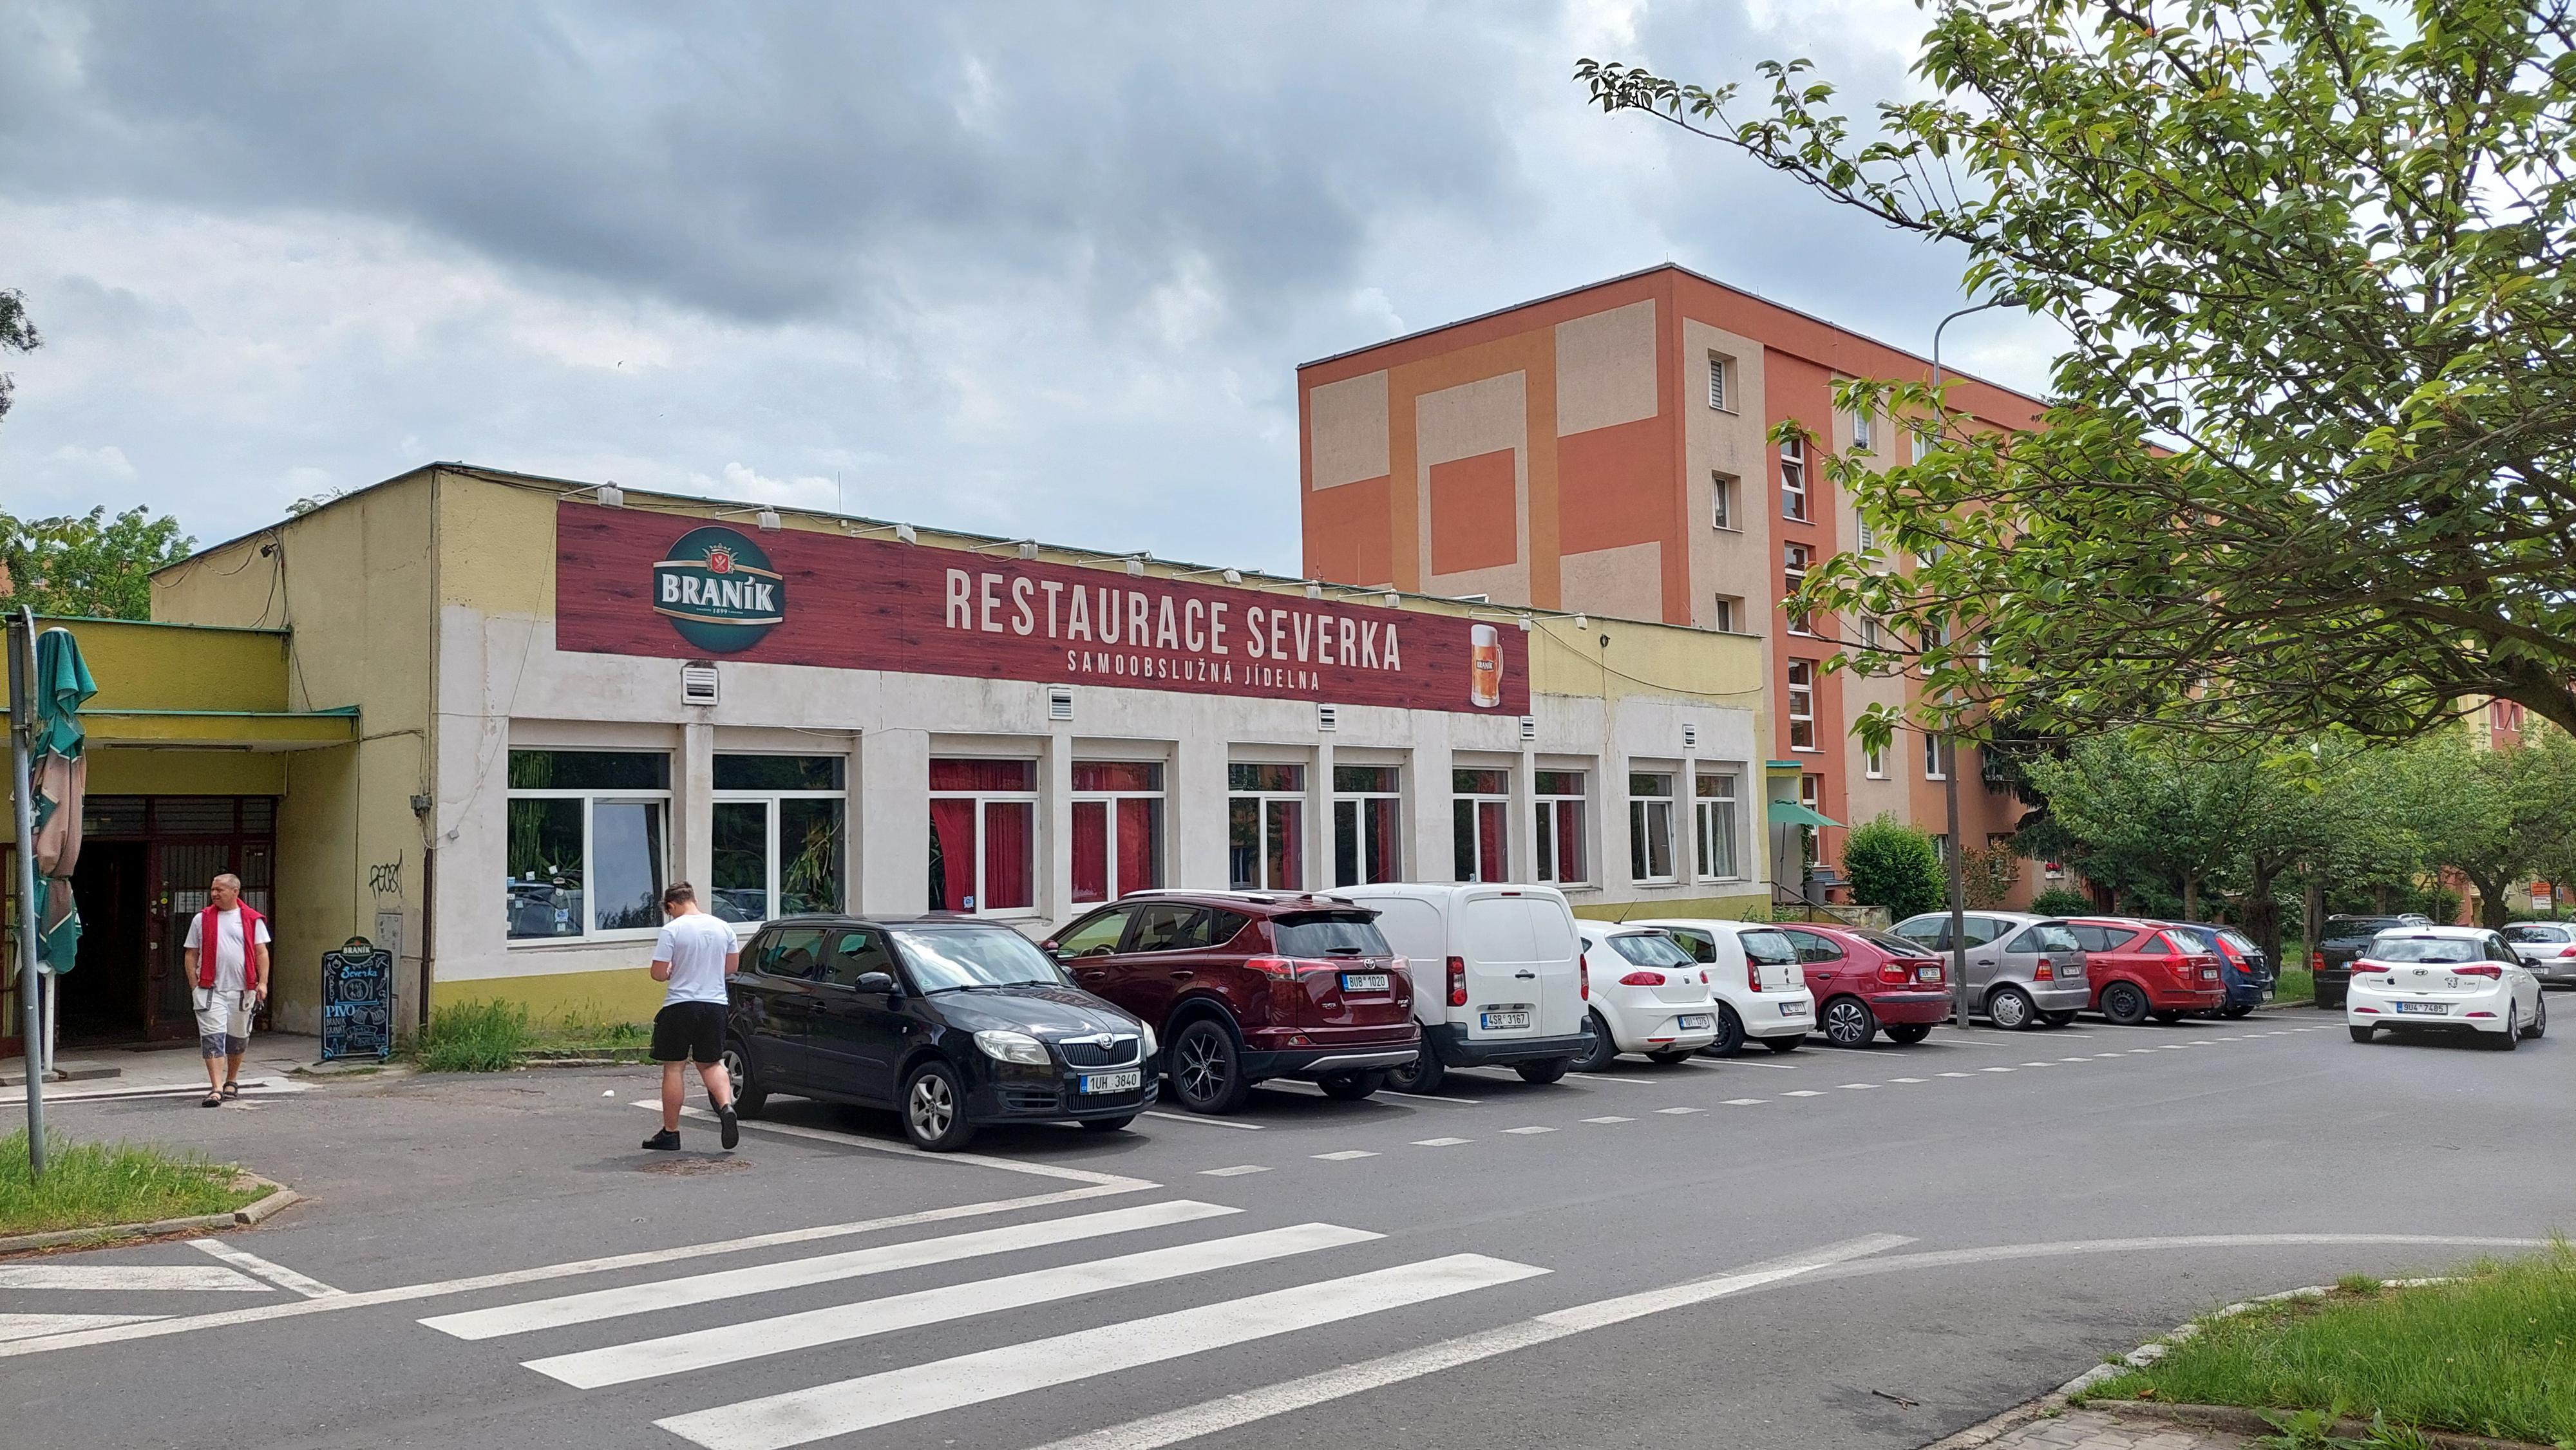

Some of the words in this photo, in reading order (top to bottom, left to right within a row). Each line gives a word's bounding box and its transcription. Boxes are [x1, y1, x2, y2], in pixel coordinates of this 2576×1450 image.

[661, 573, 776, 612] BRANÍK
[945, 567, 1229, 655] RESTAURACE
[1246, 606, 1401, 672] SEVERKA
[1067, 650, 1233, 684] SAMOOBSLUŽNÁ
[1244, 664, 1320, 691] JÍDELNA
[343, 945, 372, 954] BRANÍK
[341, 966, 378, 979] Severka
[1349, 976, 1363, 987] 8U8
[1368, 975, 1385, 986] 1020
[326, 1004, 355, 1017] PIVO
[1489, 1015, 1502, 1025] 4SR
[1507, 1013, 1525, 1024] 3167
[1090, 1076, 1108, 1090] 1UH
[1115, 1073, 1137, 1088] 3840
